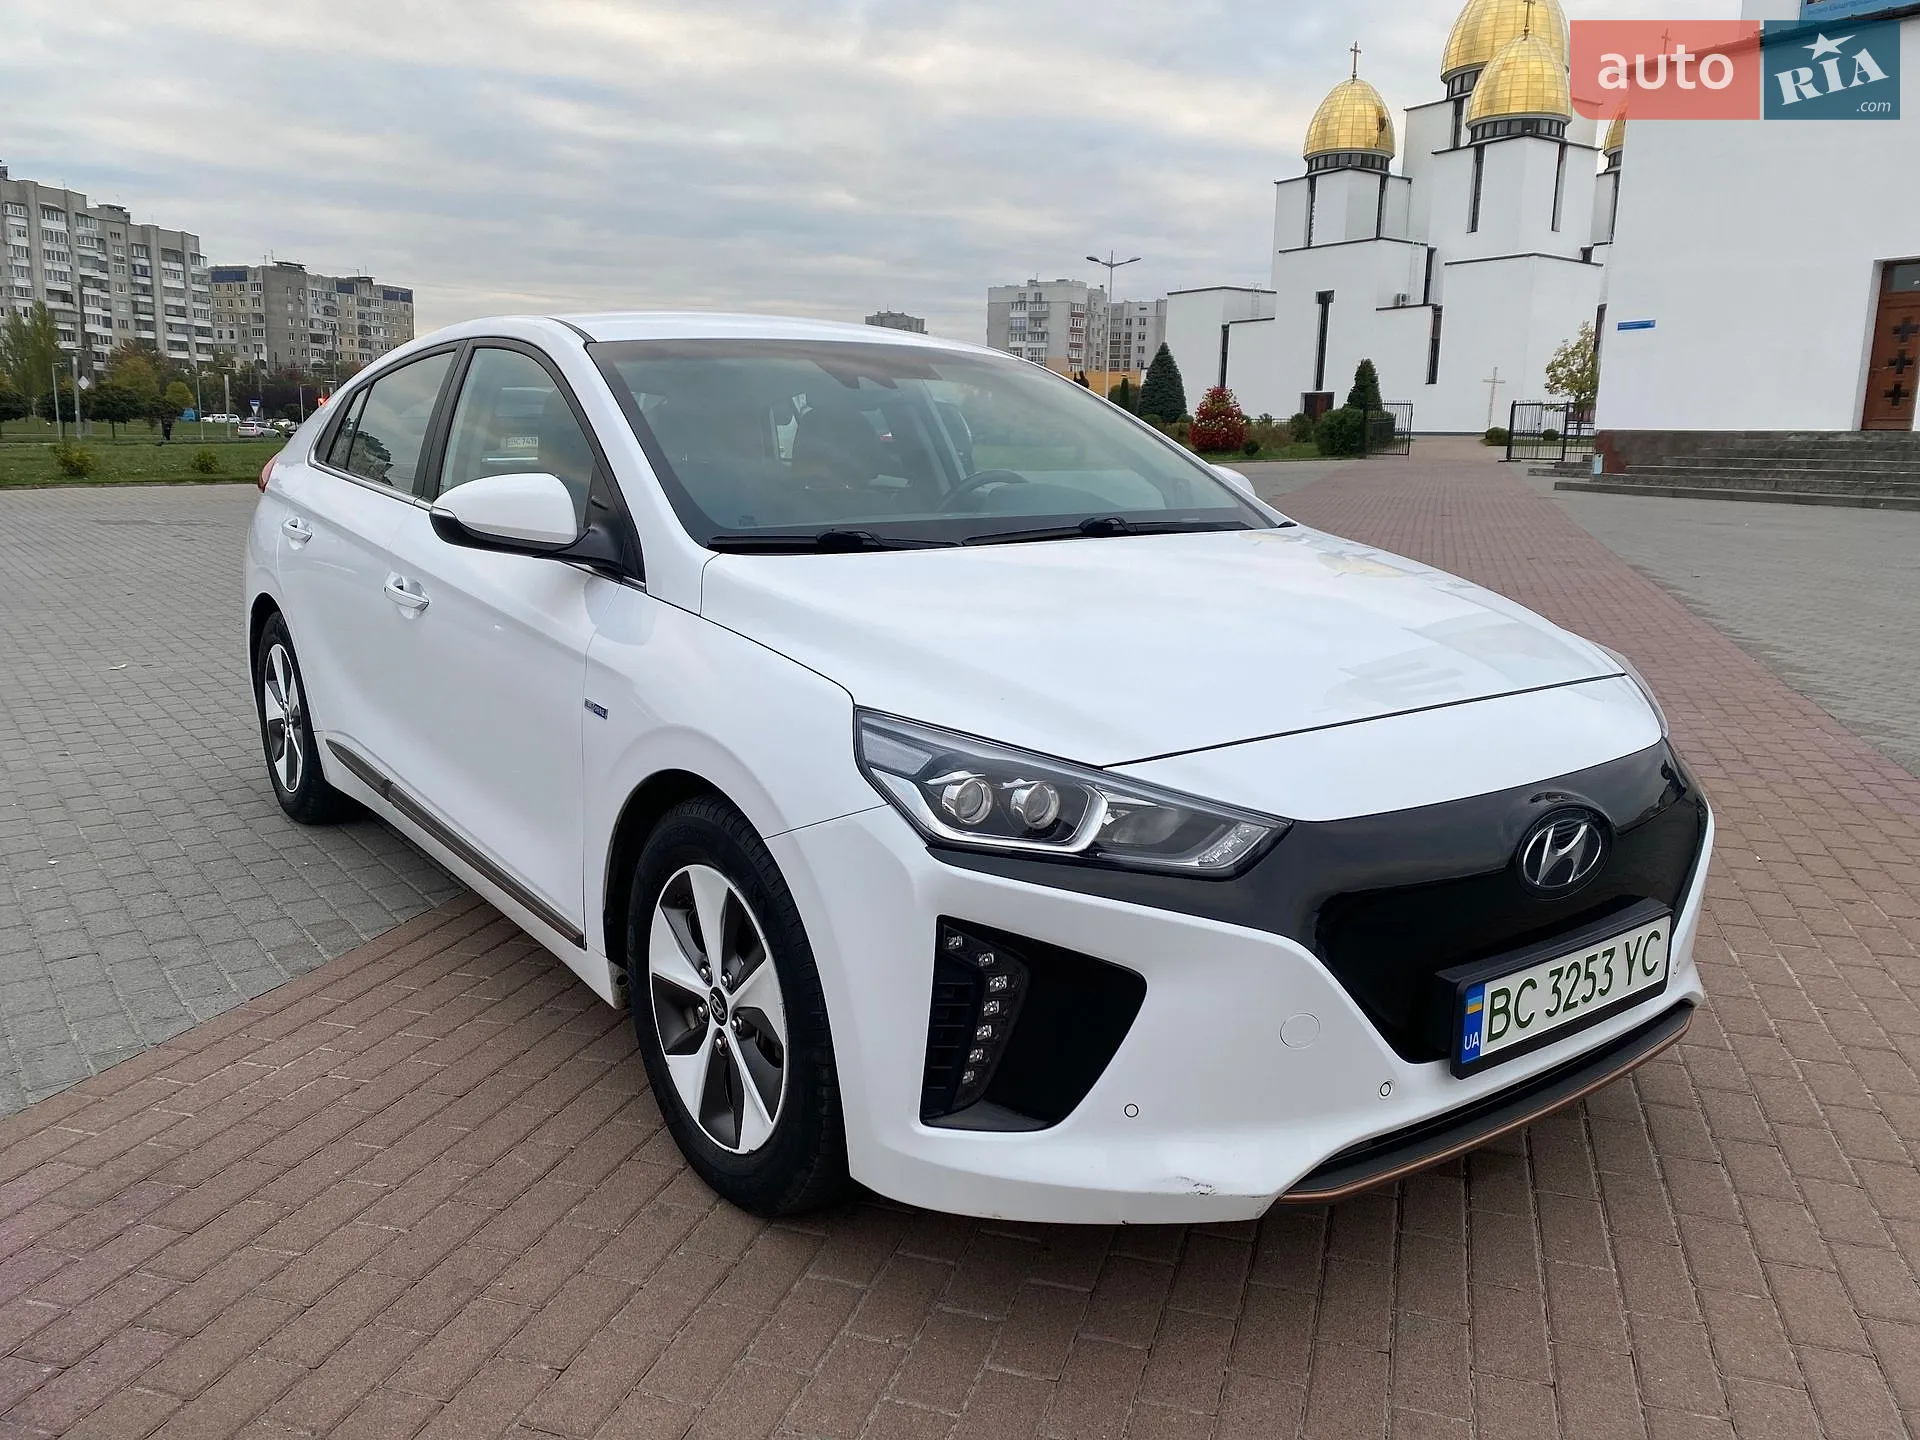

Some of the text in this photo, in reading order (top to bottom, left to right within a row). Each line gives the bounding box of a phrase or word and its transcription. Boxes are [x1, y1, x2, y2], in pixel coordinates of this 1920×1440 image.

[1486, 930, 1661, 1042] BC 3253 YC
[1464, 1032, 1479, 1050] UA
